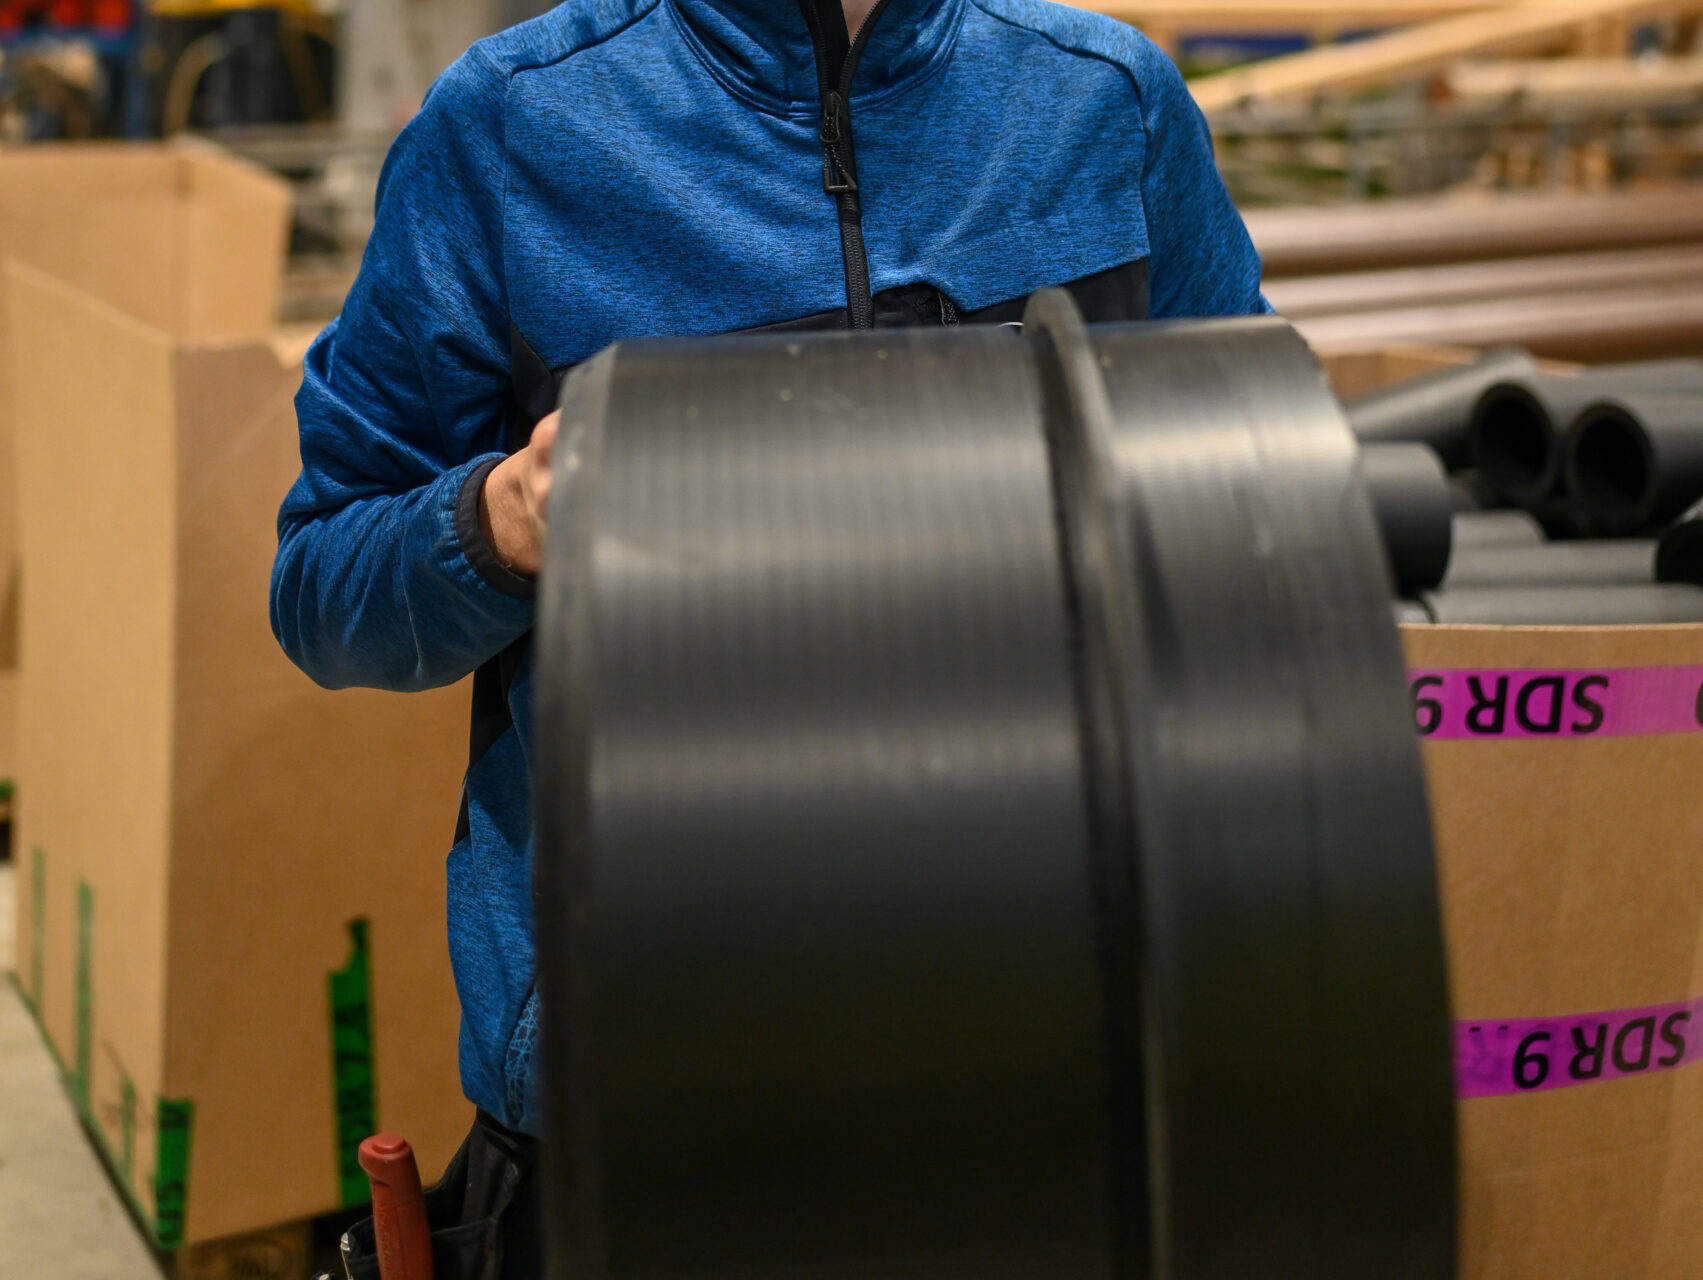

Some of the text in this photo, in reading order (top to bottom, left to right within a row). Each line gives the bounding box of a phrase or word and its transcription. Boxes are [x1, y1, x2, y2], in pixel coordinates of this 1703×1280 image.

[1408, 675, 1609, 736] SDR 9
[1512, 1031, 1550, 1090] 9
[1569, 1011, 1691, 1081] SDR
